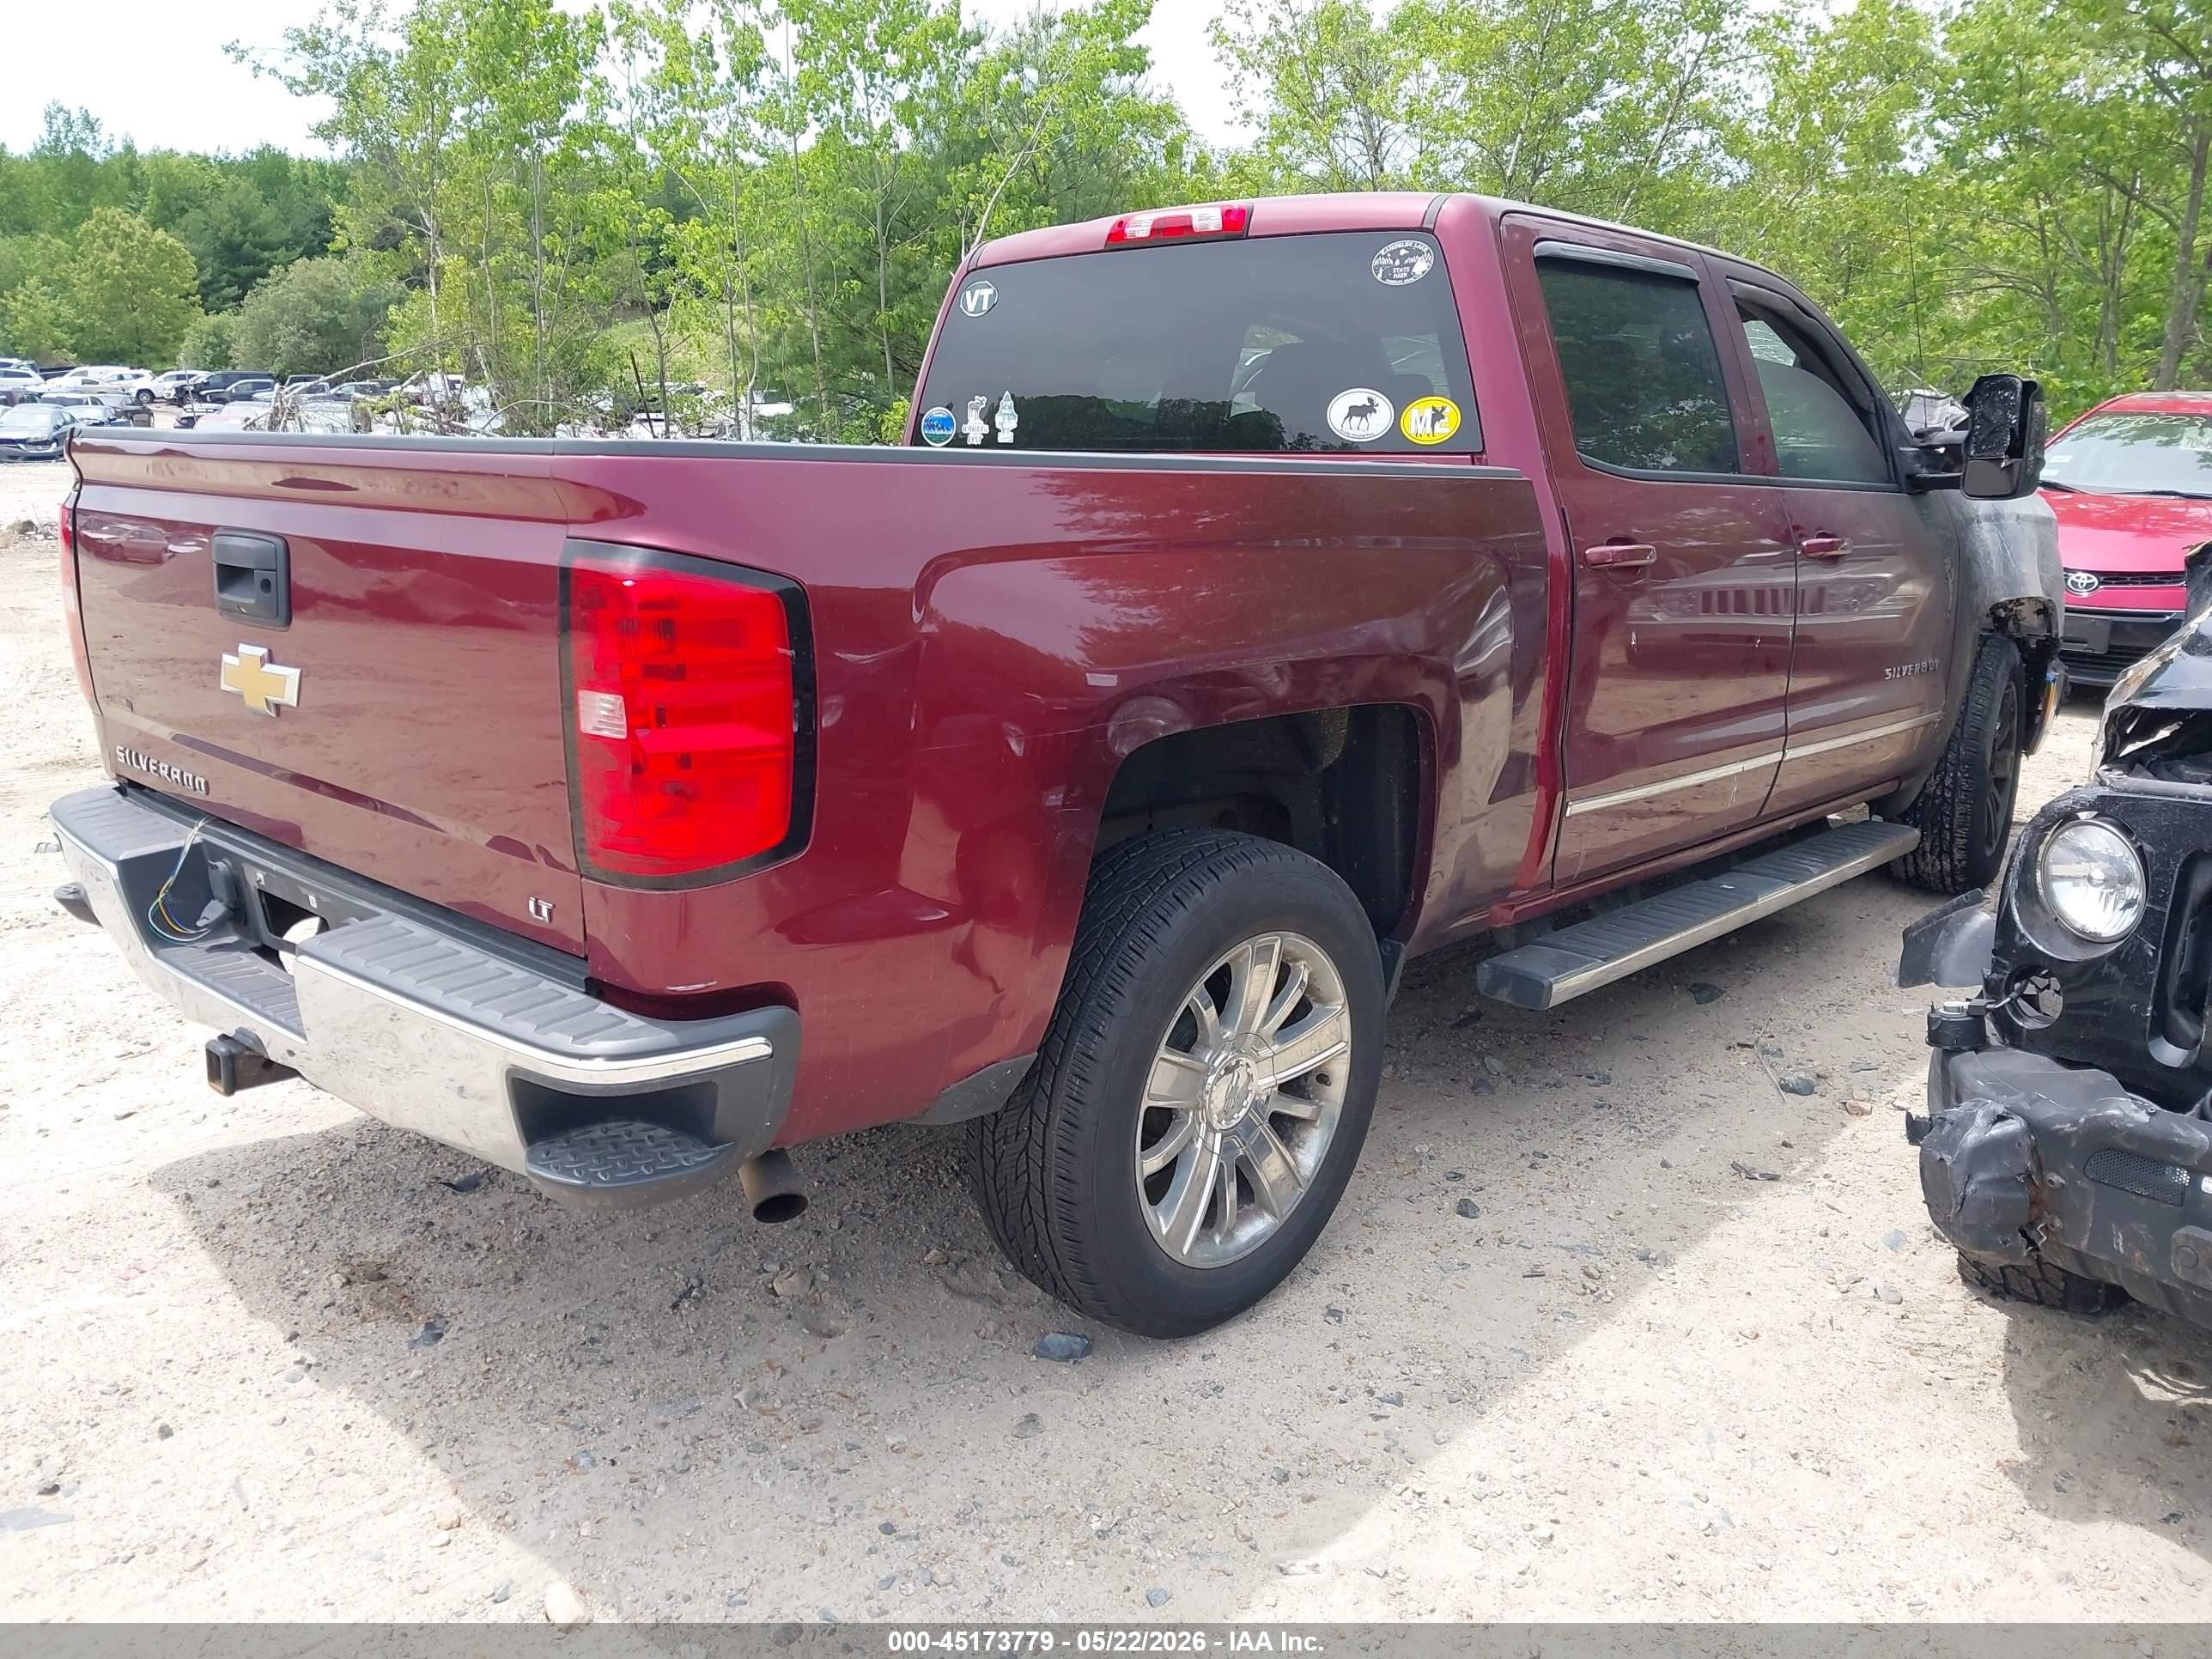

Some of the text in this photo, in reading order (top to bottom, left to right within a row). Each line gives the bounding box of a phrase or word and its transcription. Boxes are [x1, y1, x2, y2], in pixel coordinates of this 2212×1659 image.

[965, 288, 994, 313] VT
[1409, 407, 1451, 434] ME
[116, 745, 207, 796] SILVERADO
[528, 896, 554, 923] LT
